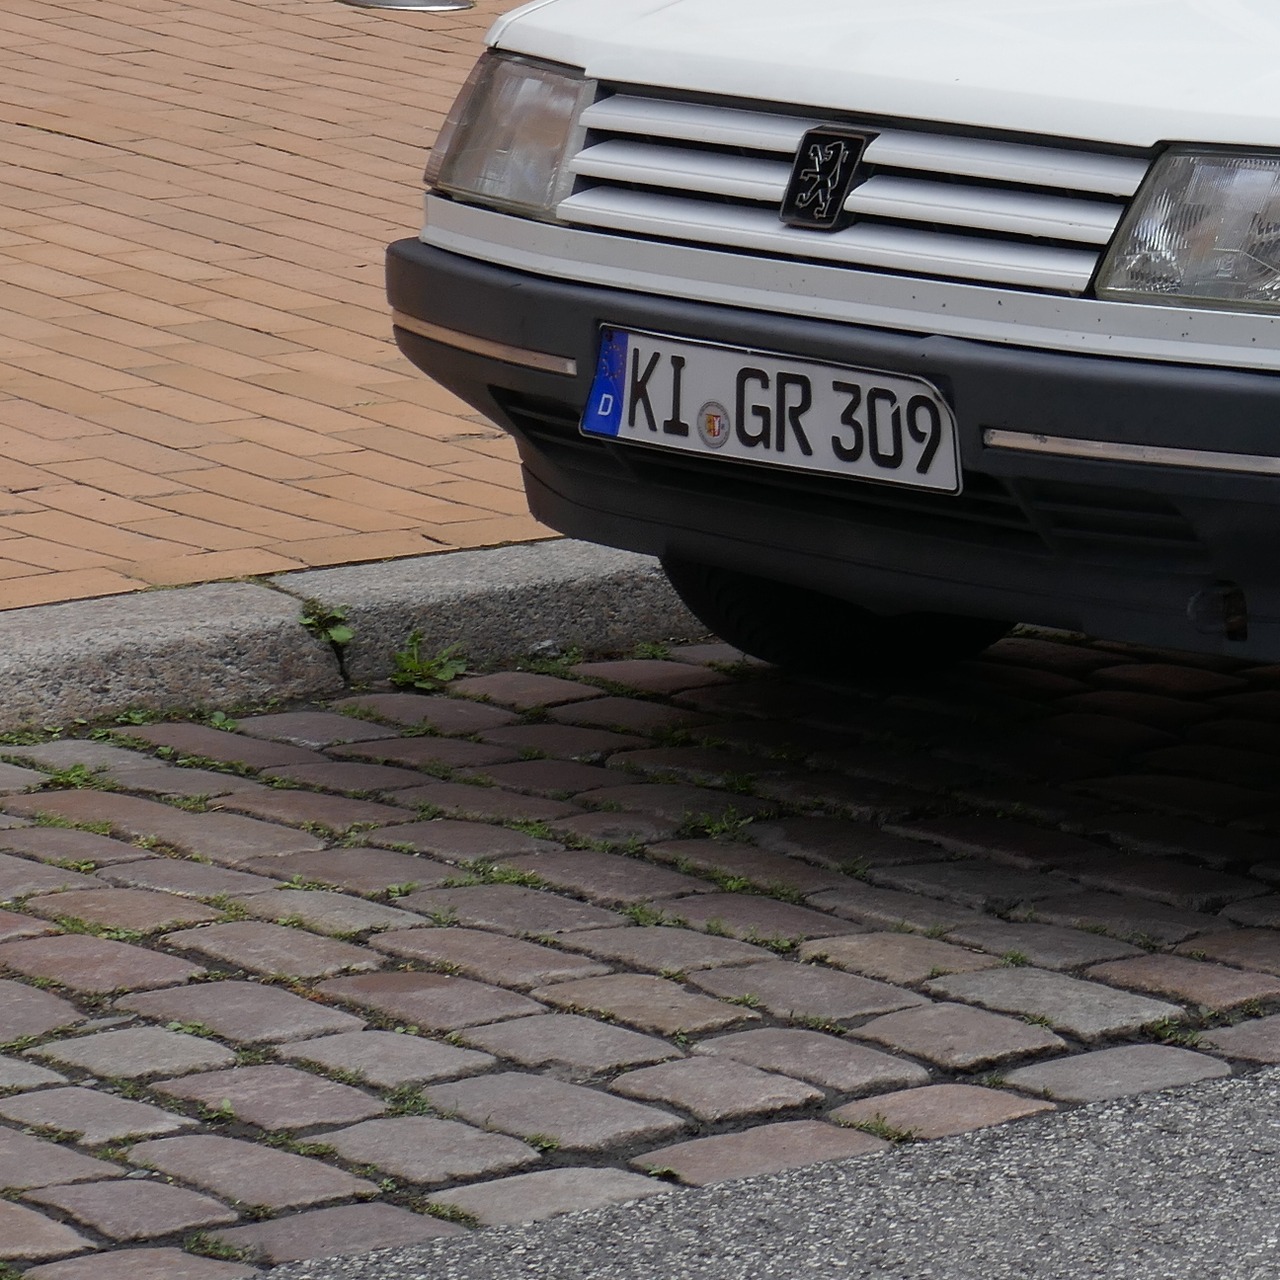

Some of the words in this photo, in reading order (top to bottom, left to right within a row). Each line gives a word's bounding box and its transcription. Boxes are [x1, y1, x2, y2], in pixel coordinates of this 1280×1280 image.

[597, 393, 614, 417] D
[628, 347, 690, 437] KI
[734, 366, 814, 456] GR
[830, 380, 943, 475] 309
